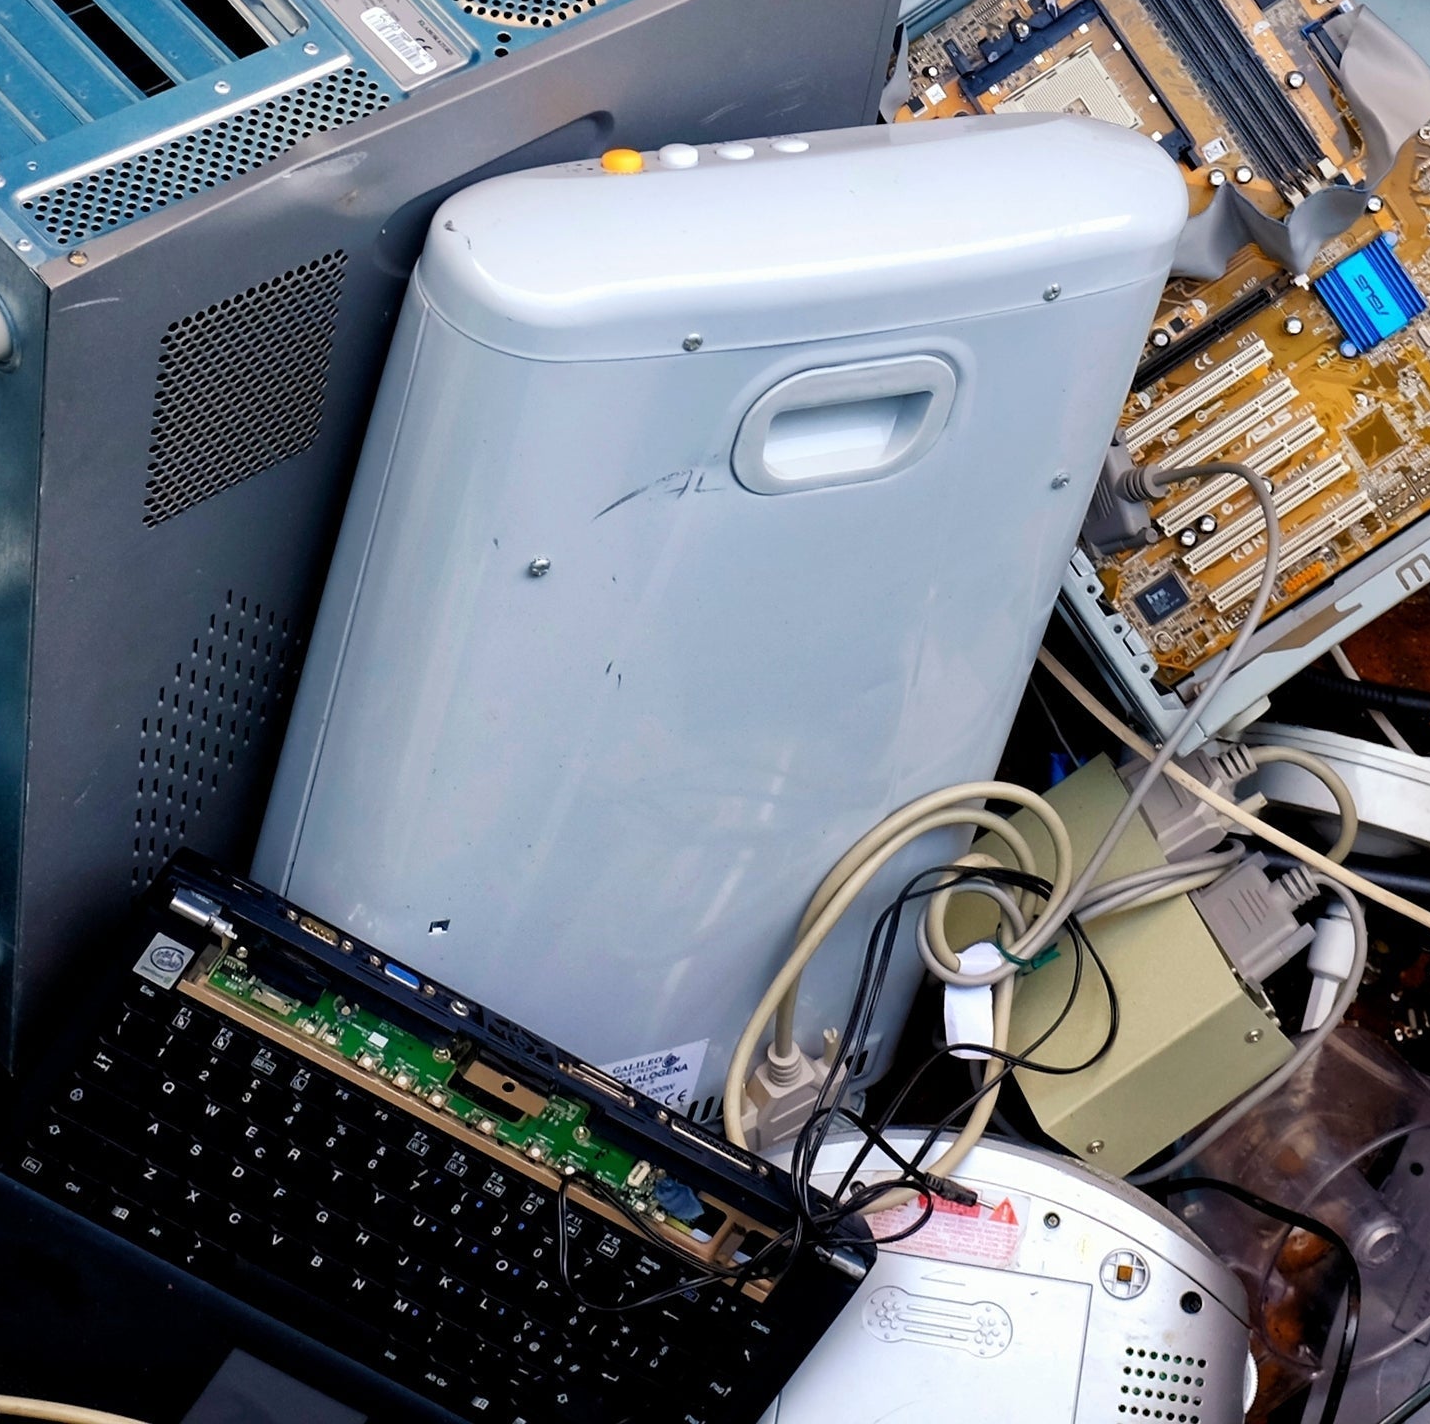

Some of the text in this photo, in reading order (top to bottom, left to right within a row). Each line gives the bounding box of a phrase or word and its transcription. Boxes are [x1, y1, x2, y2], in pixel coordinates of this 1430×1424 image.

[1354, 273, 1390, 317] ASUS
[1244, 408, 1293, 449] ASUS
[140, 984, 156, 998] Esc
[180, 1007, 193, 1018] F1
[221, 1027, 234, 1039] F2
[259, 1048, 272, 1059] F3
[612, 1056, 663, 1074] GALILEO
[198, 1070, 209, 1081] 2
[297, 1069, 311, 1080] F4
[634, 1063, 689, 1084] ALOGENA
[162, 1081, 175, 1094] Q
[242, 1092, 252, 1103] 3
[205, 1103, 220, 1118] W
[284, 1115, 294, 1125] 4
[147, 1122, 160, 1135] A
[245, 1126, 258, 1138] E
[326, 1137, 336, 1148] 5
[413, 1131, 428, 1142] F7
[190, 1144, 202, 1157] S
[287, 1148, 301, 1161] R
[452, 1151, 466, 1162] F8
[25, 1159, 38, 1172] Fn
[367, 1159, 378, 1170] 6
[143, 1168, 157, 1180] Z
[231, 1166, 244, 1178] D
[331, 1170, 343, 1182] T
[490, 1171, 504, 1183] F9
[409, 1180, 421, 1191] 7
[186, 1189, 200, 1203] X
[274, 1187, 286, 1199] F
[374, 1192, 385, 1204] Y
[450, 1204, 461, 1215] 8
[229, 1212, 242, 1225] C
[316, 1211, 329, 1223] G
[413, 1215, 426, 1227] U
[491, 1226, 502, 1237] 9
[271, 1234, 283, 1246] V
[356, 1232, 370, 1246] H
[310, 1255, 323, 1268] B
[398, 1256, 410, 1267] J
[495, 1259, 509, 1271] O
[352, 1278, 366, 1291] N
[439, 1276, 453, 1289] K
[536, 1279, 549, 1291] P
[393, 1299, 409, 1313] M
[479, 1297, 488, 1310] L
